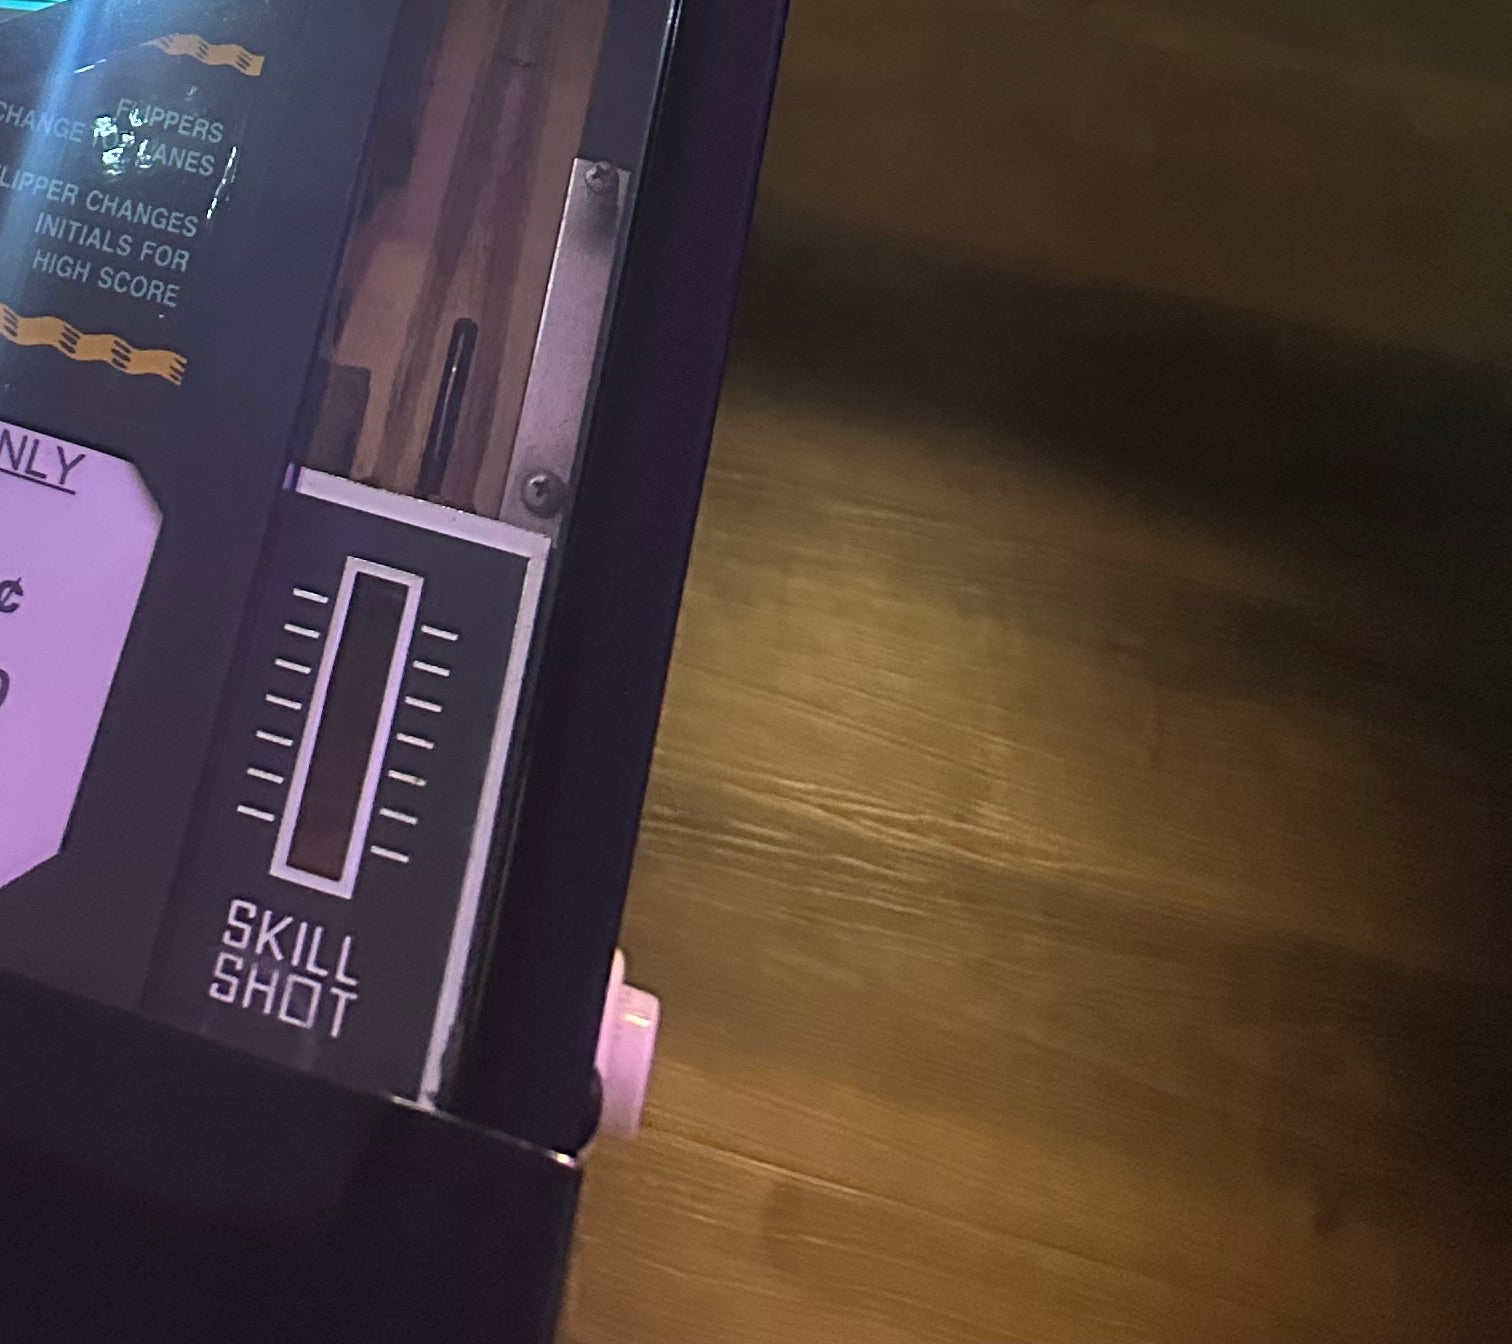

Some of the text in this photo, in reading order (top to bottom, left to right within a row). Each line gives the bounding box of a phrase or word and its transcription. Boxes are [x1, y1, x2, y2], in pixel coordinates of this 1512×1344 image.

[135, 139, 216, 177] ANES
[86, 189, 199, 237] CHANGES
[35, 213, 190, 273] INITIALS FOR
[33, 250, 181, 307] HIGH SCORE
[221, 898, 359, 987] SKILL
[209, 952, 359, 1037] SHOT
